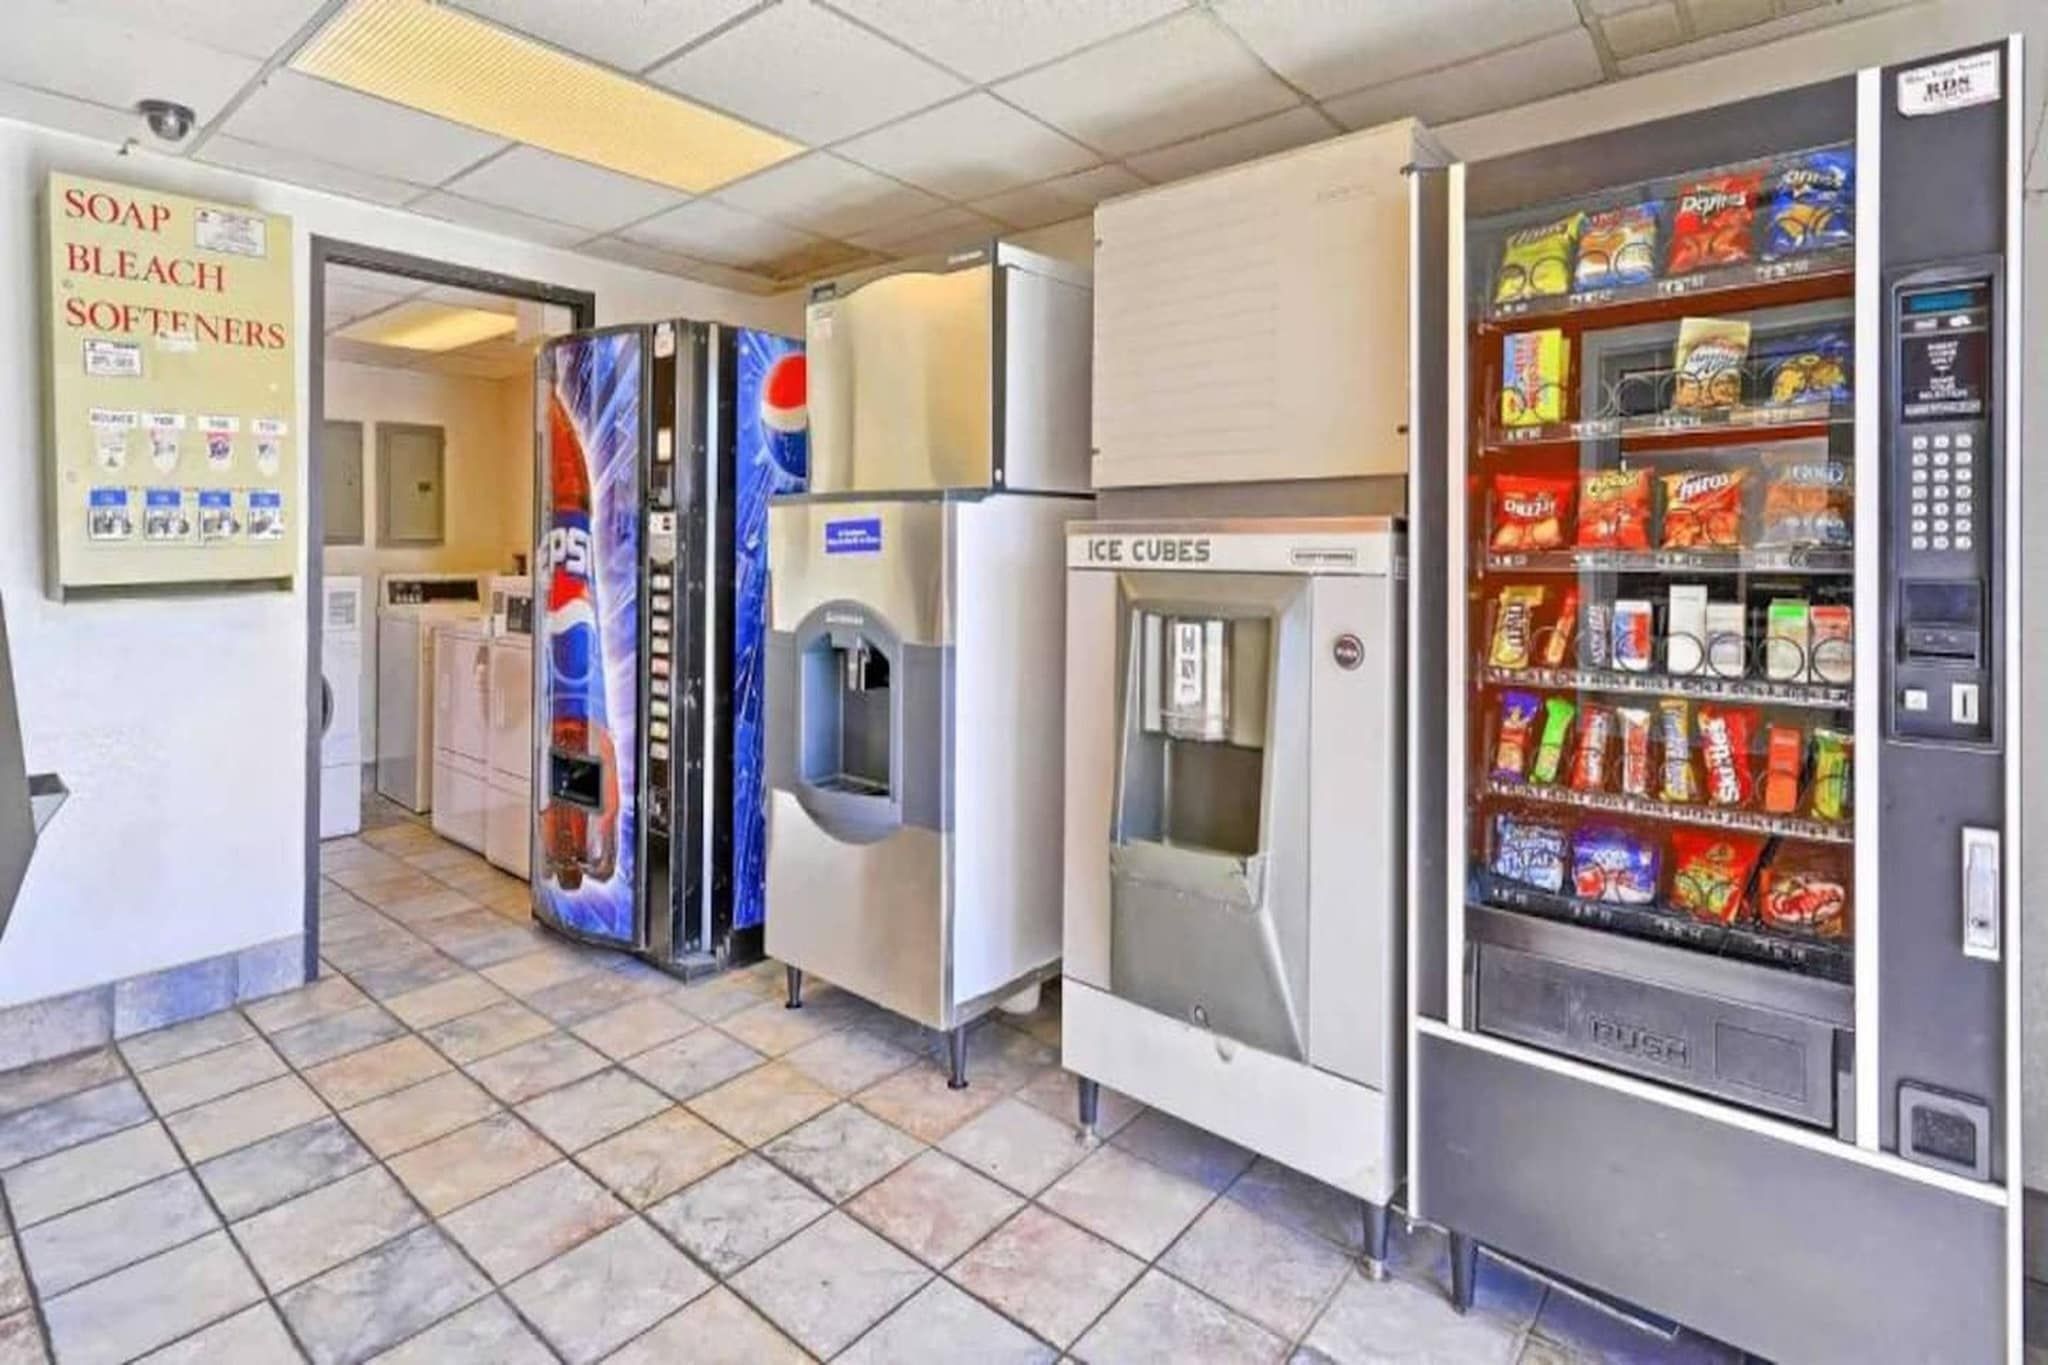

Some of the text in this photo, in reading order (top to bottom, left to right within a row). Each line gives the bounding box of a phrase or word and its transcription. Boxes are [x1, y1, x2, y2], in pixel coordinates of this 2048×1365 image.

[64, 188, 171, 233] SOAP
[65, 242, 224, 293] BLEACH
[66, 297, 285, 349] SOFTENERS
[1088, 540, 1211, 562] ICE CUBES
[1590, 1014, 1690, 1069] PUSH
